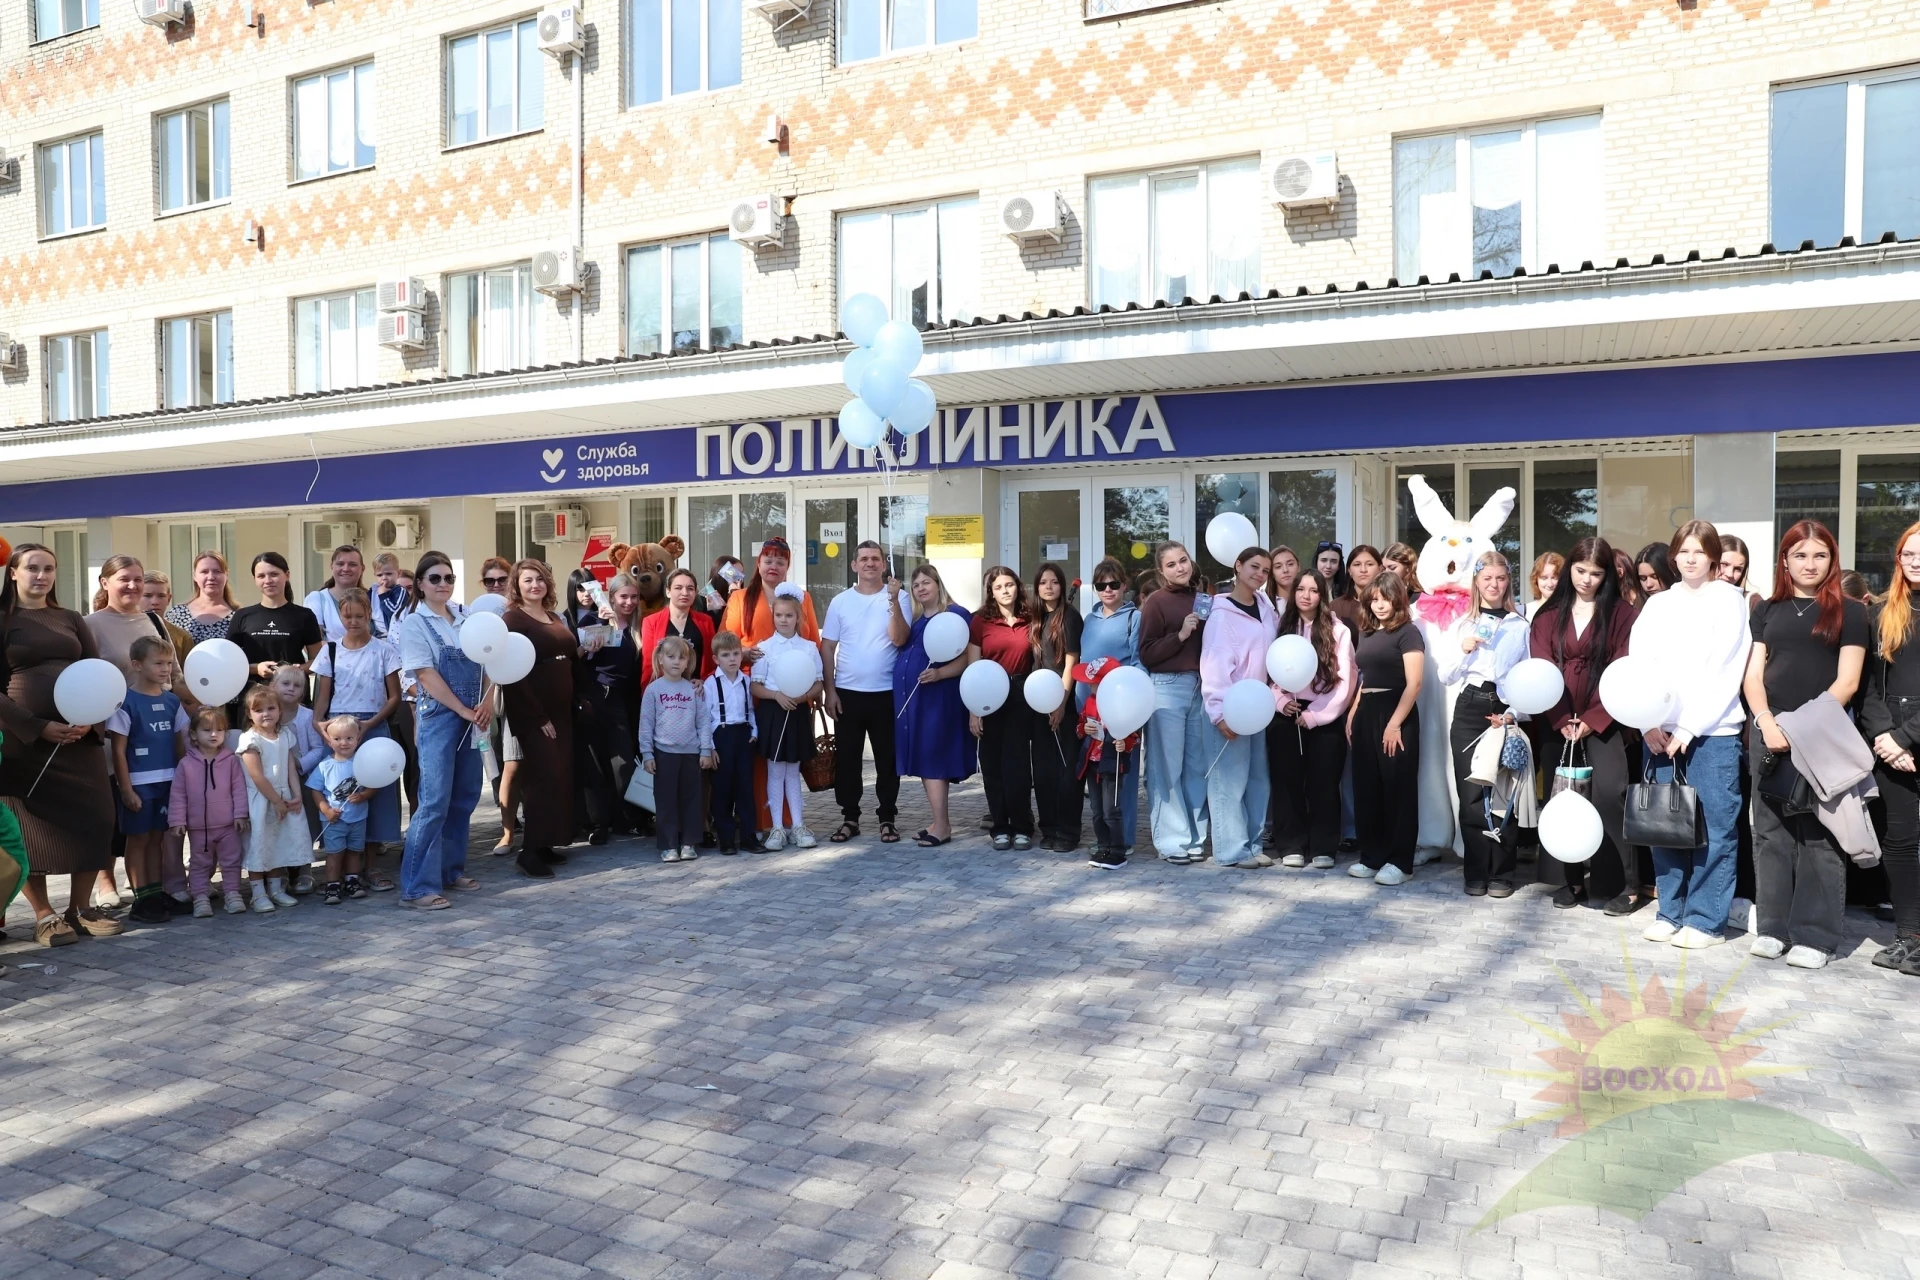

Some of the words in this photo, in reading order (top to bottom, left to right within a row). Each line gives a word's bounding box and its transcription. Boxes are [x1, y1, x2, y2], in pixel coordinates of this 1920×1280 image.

[696, 395, 1176, 478] ПОЛИКЛИНИКА
[577, 442, 637, 463] Служба
[577, 463, 649, 481] здоровья
[824, 529, 843, 537] Вход
[660, 693, 692, 704] Positive
[149, 721, 172, 732] YES
